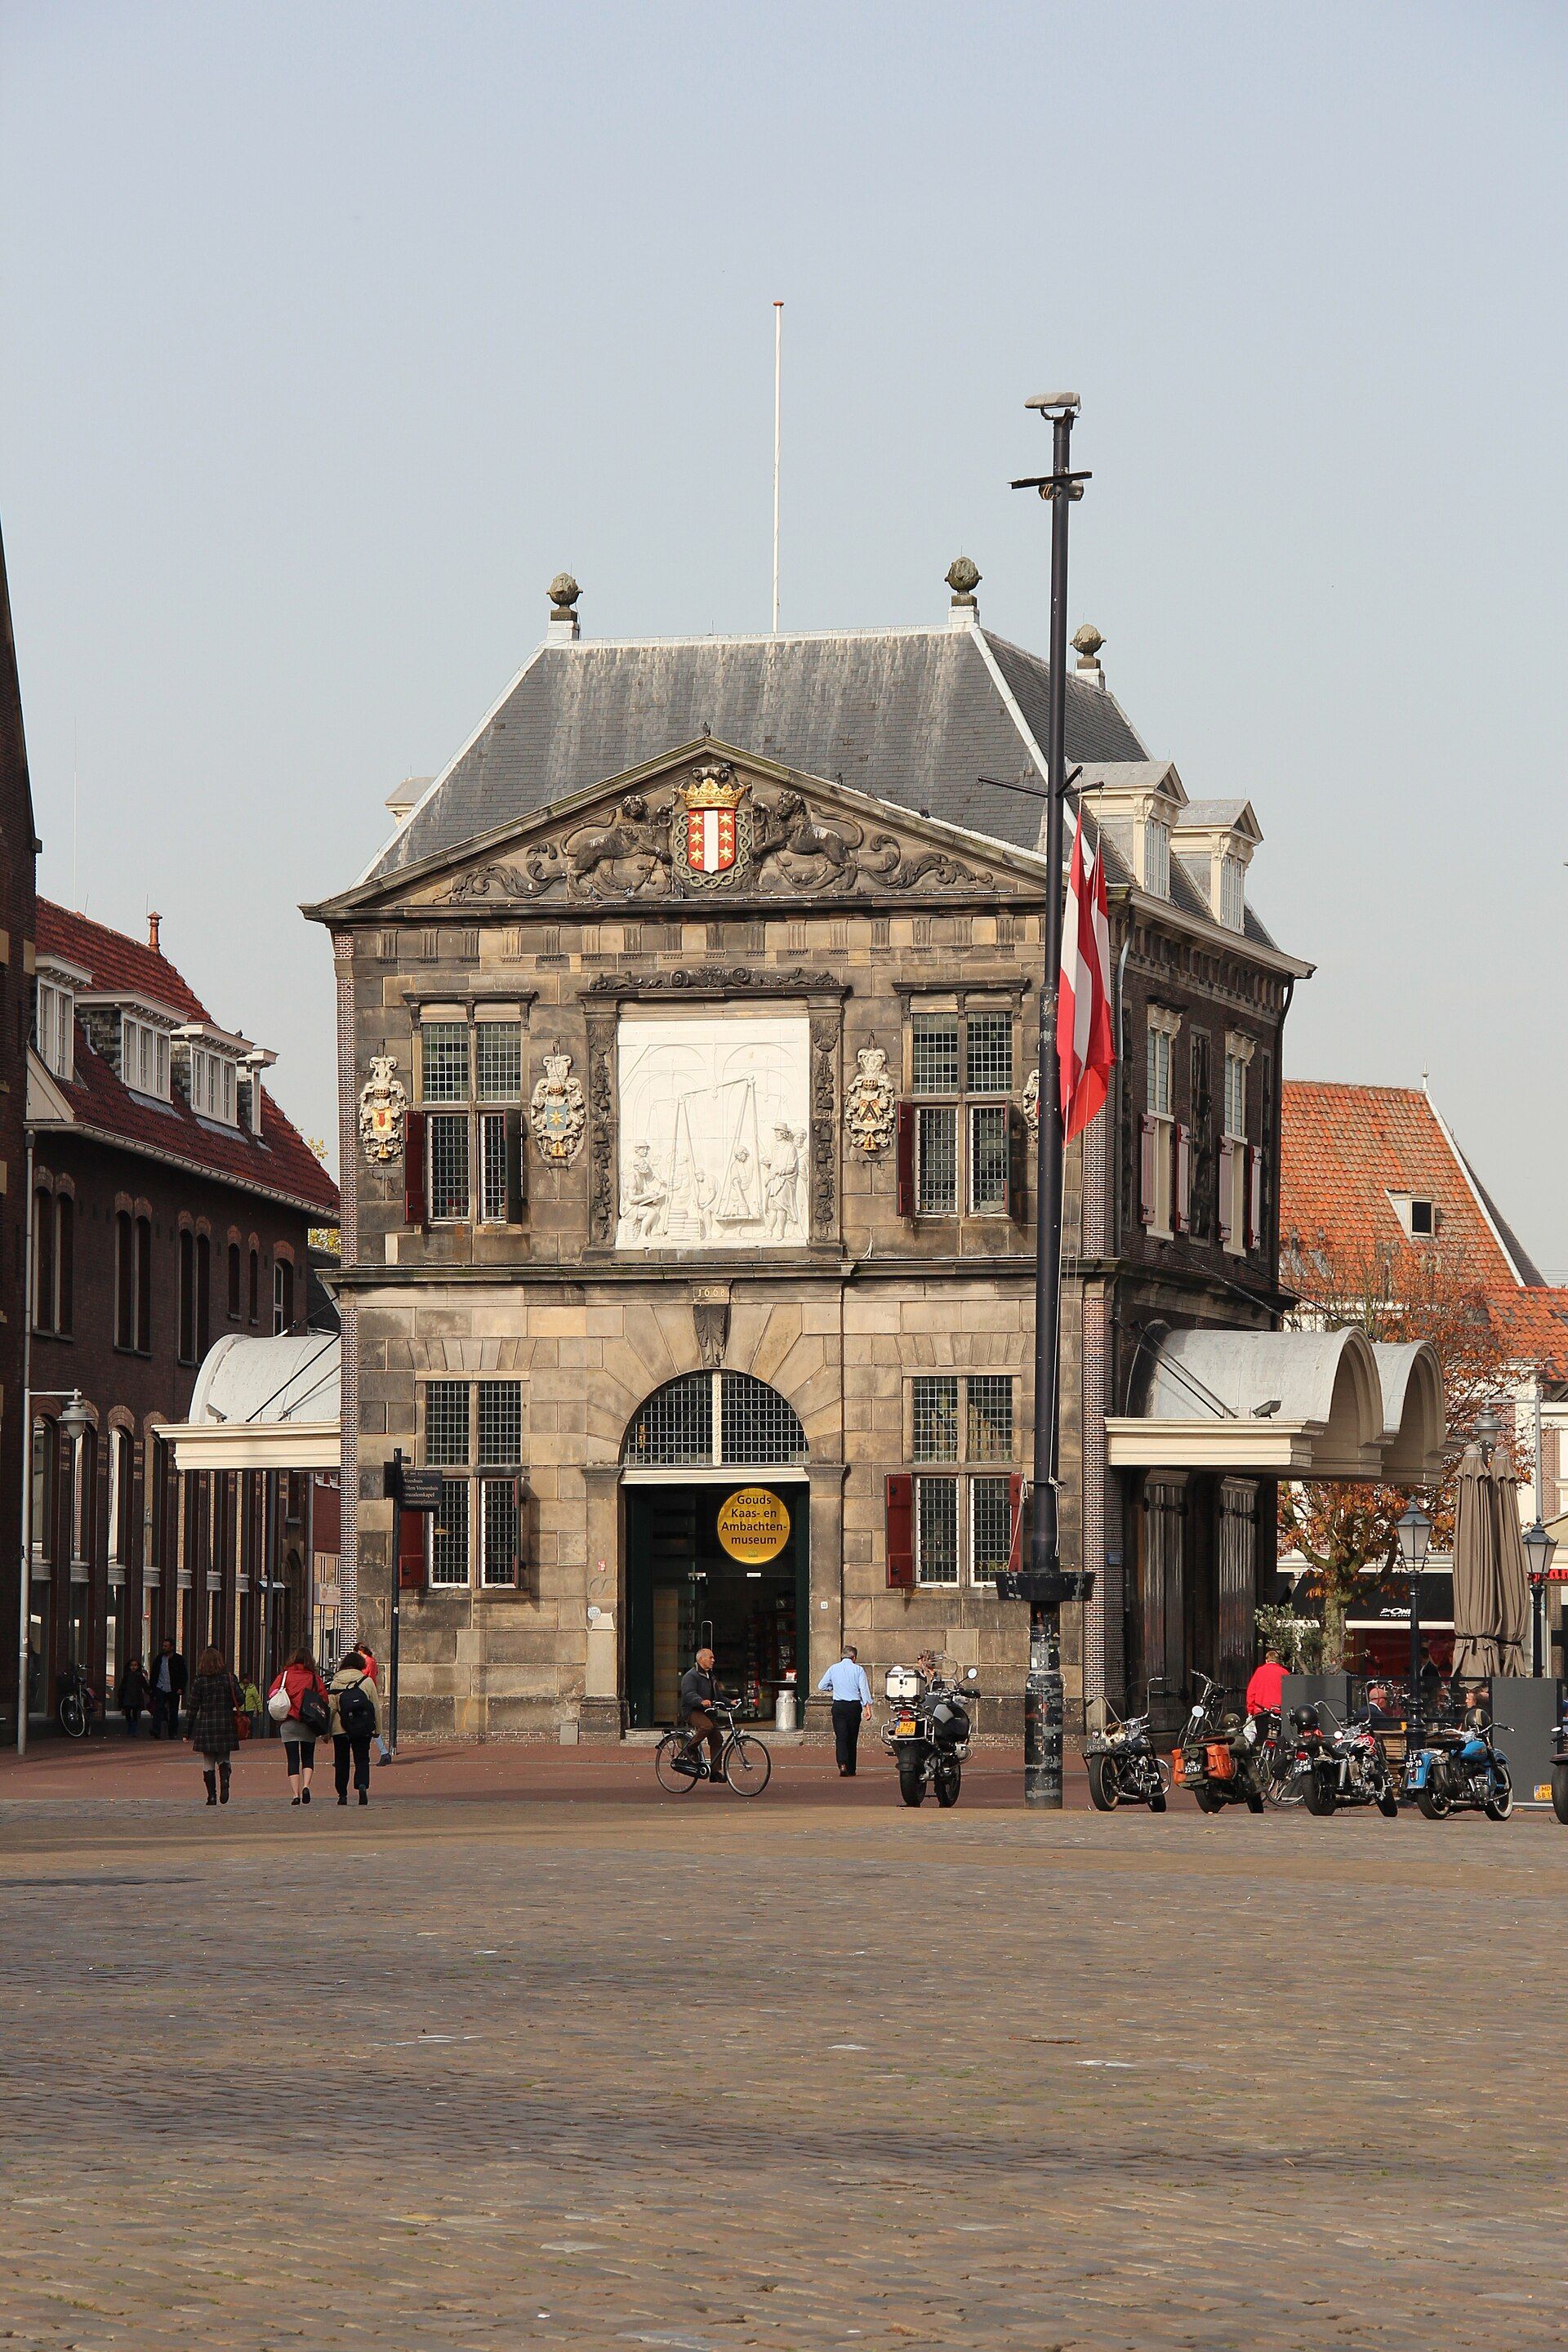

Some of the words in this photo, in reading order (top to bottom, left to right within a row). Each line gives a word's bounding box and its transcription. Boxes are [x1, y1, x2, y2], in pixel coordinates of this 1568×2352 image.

[697, 1287, 725, 1297] 1668
[737, 1494, 772, 1504] Gouds
[731, 1508, 760, 1518] Kaas-
[764, 1510, 777, 1518] en
[721, 1521, 786, 1531] Ambachten-
[1294, 1764, 1312, 1772] 20-88
[1405, 1760, 1423, 1768] 09-28
